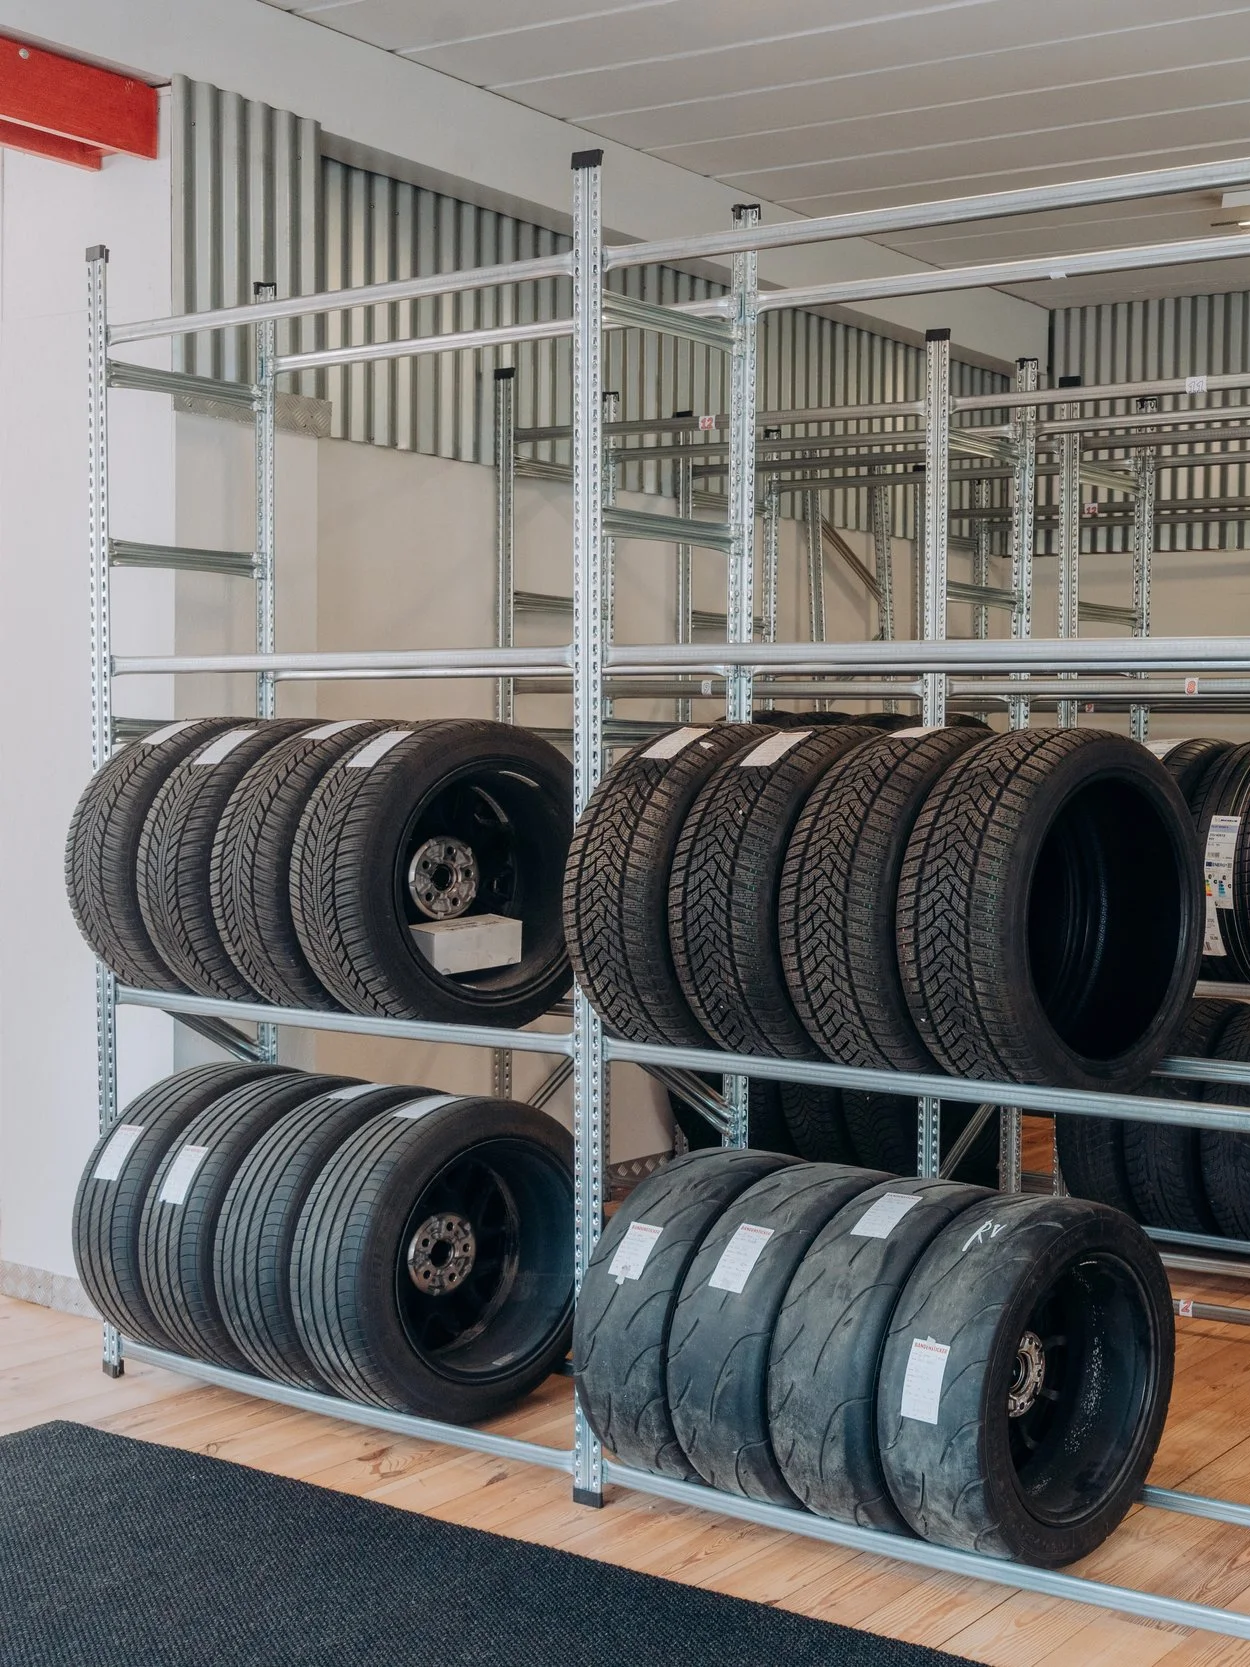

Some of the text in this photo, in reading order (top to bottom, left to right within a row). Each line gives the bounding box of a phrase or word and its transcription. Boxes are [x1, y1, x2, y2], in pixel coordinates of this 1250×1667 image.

[700, 416, 714, 429] 12
[1187, 681, 1196, 694] 8
[1182, 1300, 1191, 1312] 2
